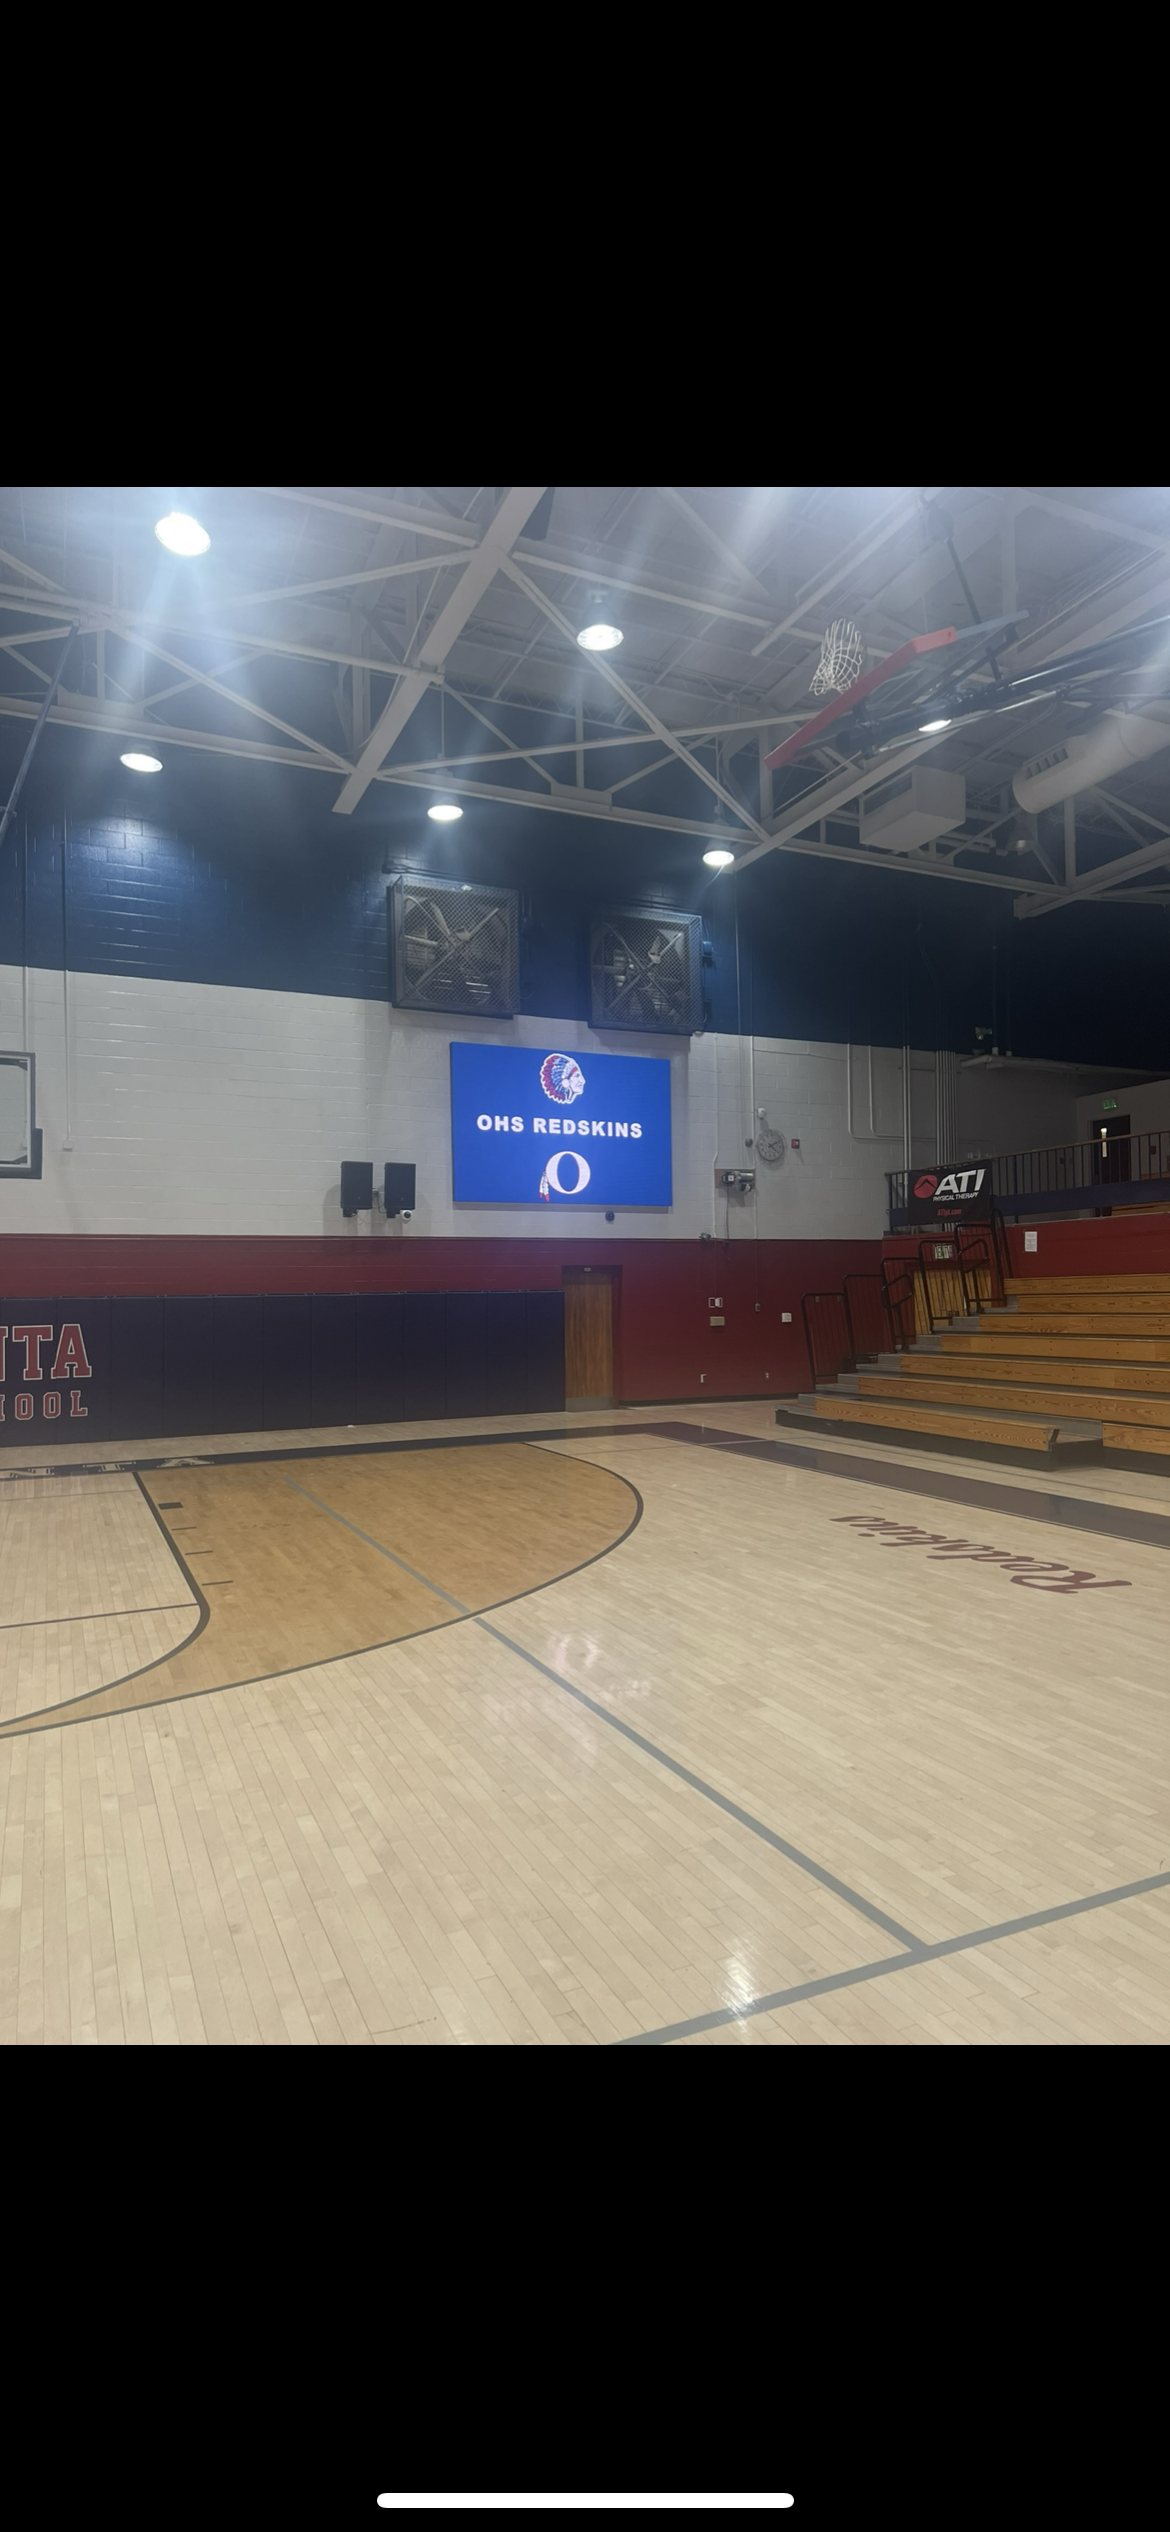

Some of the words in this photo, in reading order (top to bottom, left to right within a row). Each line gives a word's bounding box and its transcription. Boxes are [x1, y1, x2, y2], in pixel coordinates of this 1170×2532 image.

[476, 1114, 524, 1133] OHS
[533, 1117, 643, 1138] REDSKINS
[547, 1151, 590, 1194] O
[934, 1169, 986, 1195] ATI
[956, 1192, 979, 1200] THERAPY
[0, 1323, 93, 1382] TA
[0, 1390, 89, 1421] OOL
[828, 1514, 1133, 1594] Redskins
